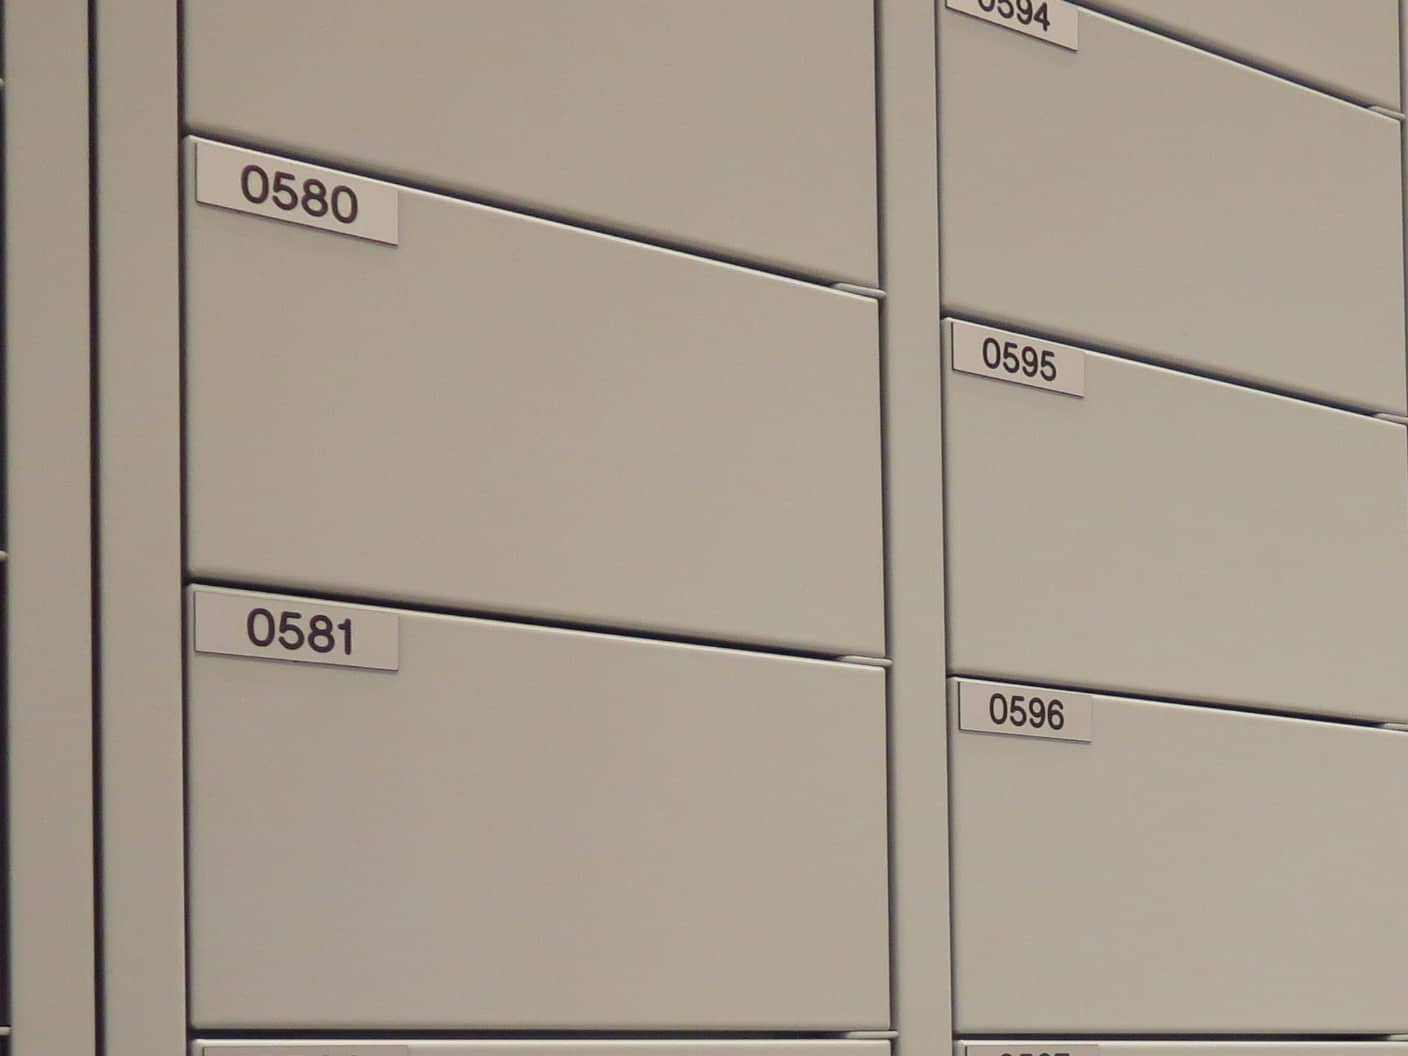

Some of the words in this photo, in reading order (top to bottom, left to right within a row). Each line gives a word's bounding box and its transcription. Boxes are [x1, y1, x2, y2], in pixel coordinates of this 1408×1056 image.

[241, 165, 357, 223] 0580
[983, 338, 1056, 381] 0595
[247, 608, 351, 655] 0581
[990, 693, 1064, 730] 0596
